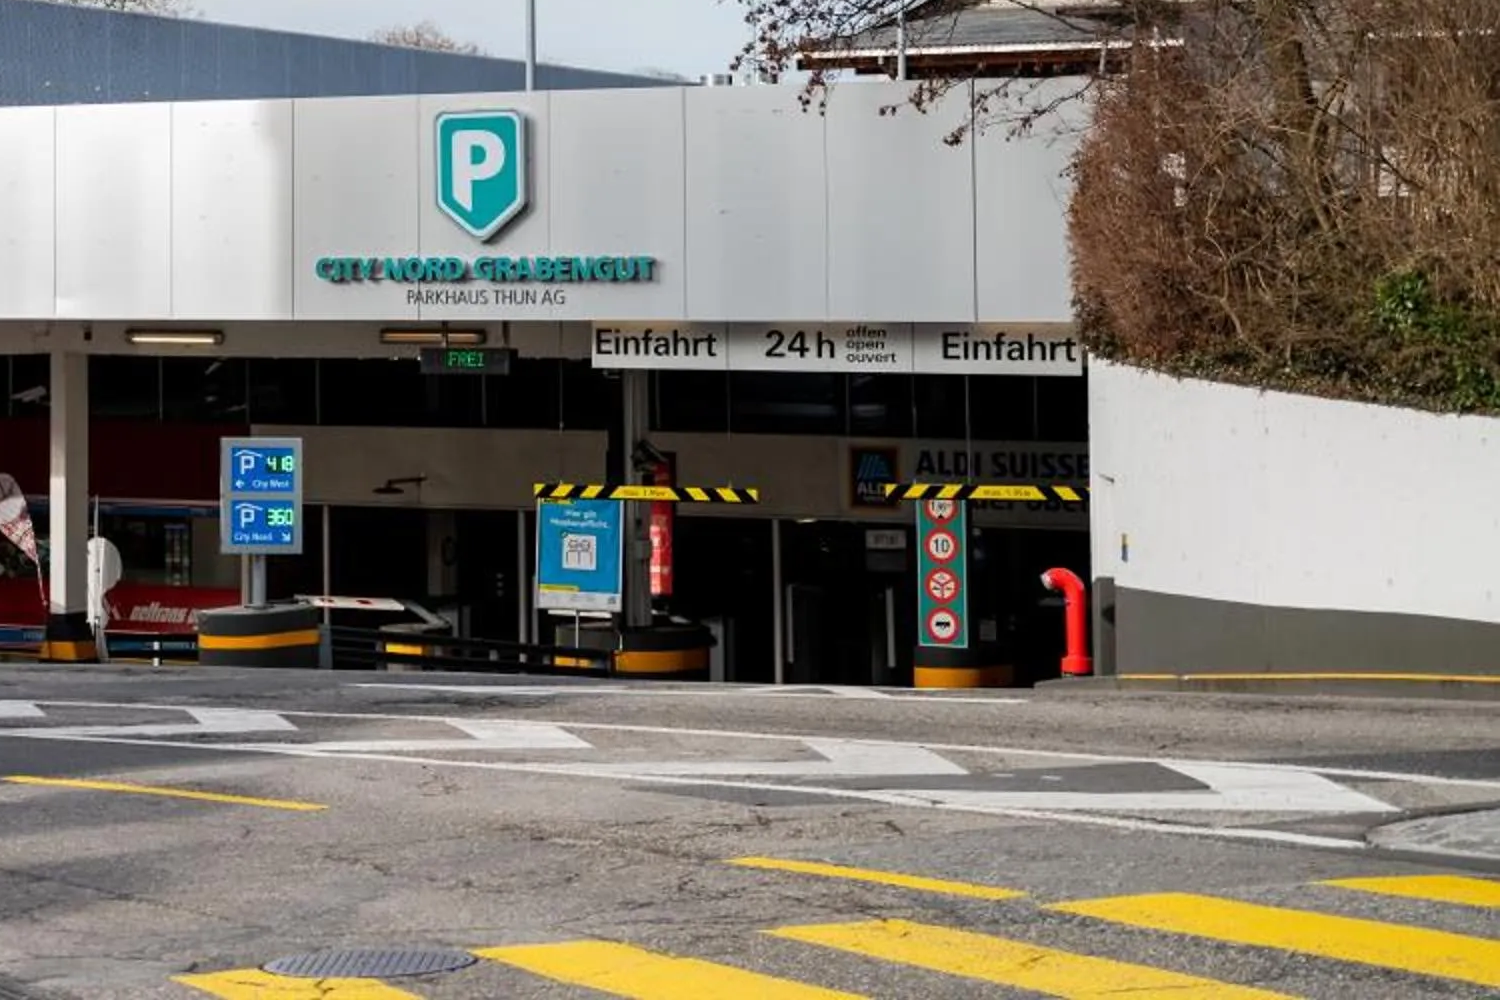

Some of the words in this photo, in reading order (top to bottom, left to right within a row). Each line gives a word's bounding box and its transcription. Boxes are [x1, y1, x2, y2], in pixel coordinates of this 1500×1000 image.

[452, 129, 506, 212] P
[316, 256, 378, 281] CITY
[384, 256, 467, 281] NORD
[474, 256, 656, 282] GRABENGUT
[407, 289, 489, 305] PARKHAUS
[494, 289, 537, 305] THUN
[542, 289, 566, 305] AG
[845, 325, 887, 339] offen
[595, 328, 717, 358] Einfahrt
[765, 329, 810, 359] 24
[816, 331, 835, 359] h
[845, 338, 885, 352] open
[942, 331, 1077, 363] Einfahrt
[845, 352, 897, 364] ouvert
[240, 455, 255, 475] P
[916, 450, 982, 476] ALDI
[991, 451, 1089, 478] SUISSE
[252, 479, 269, 490] City
[270, 479, 290, 489] West
[856, 481, 886, 496] ALD
[240, 508, 255, 529] P
[266, 508, 294, 527] 360
[933, 538, 950, 553] 10
